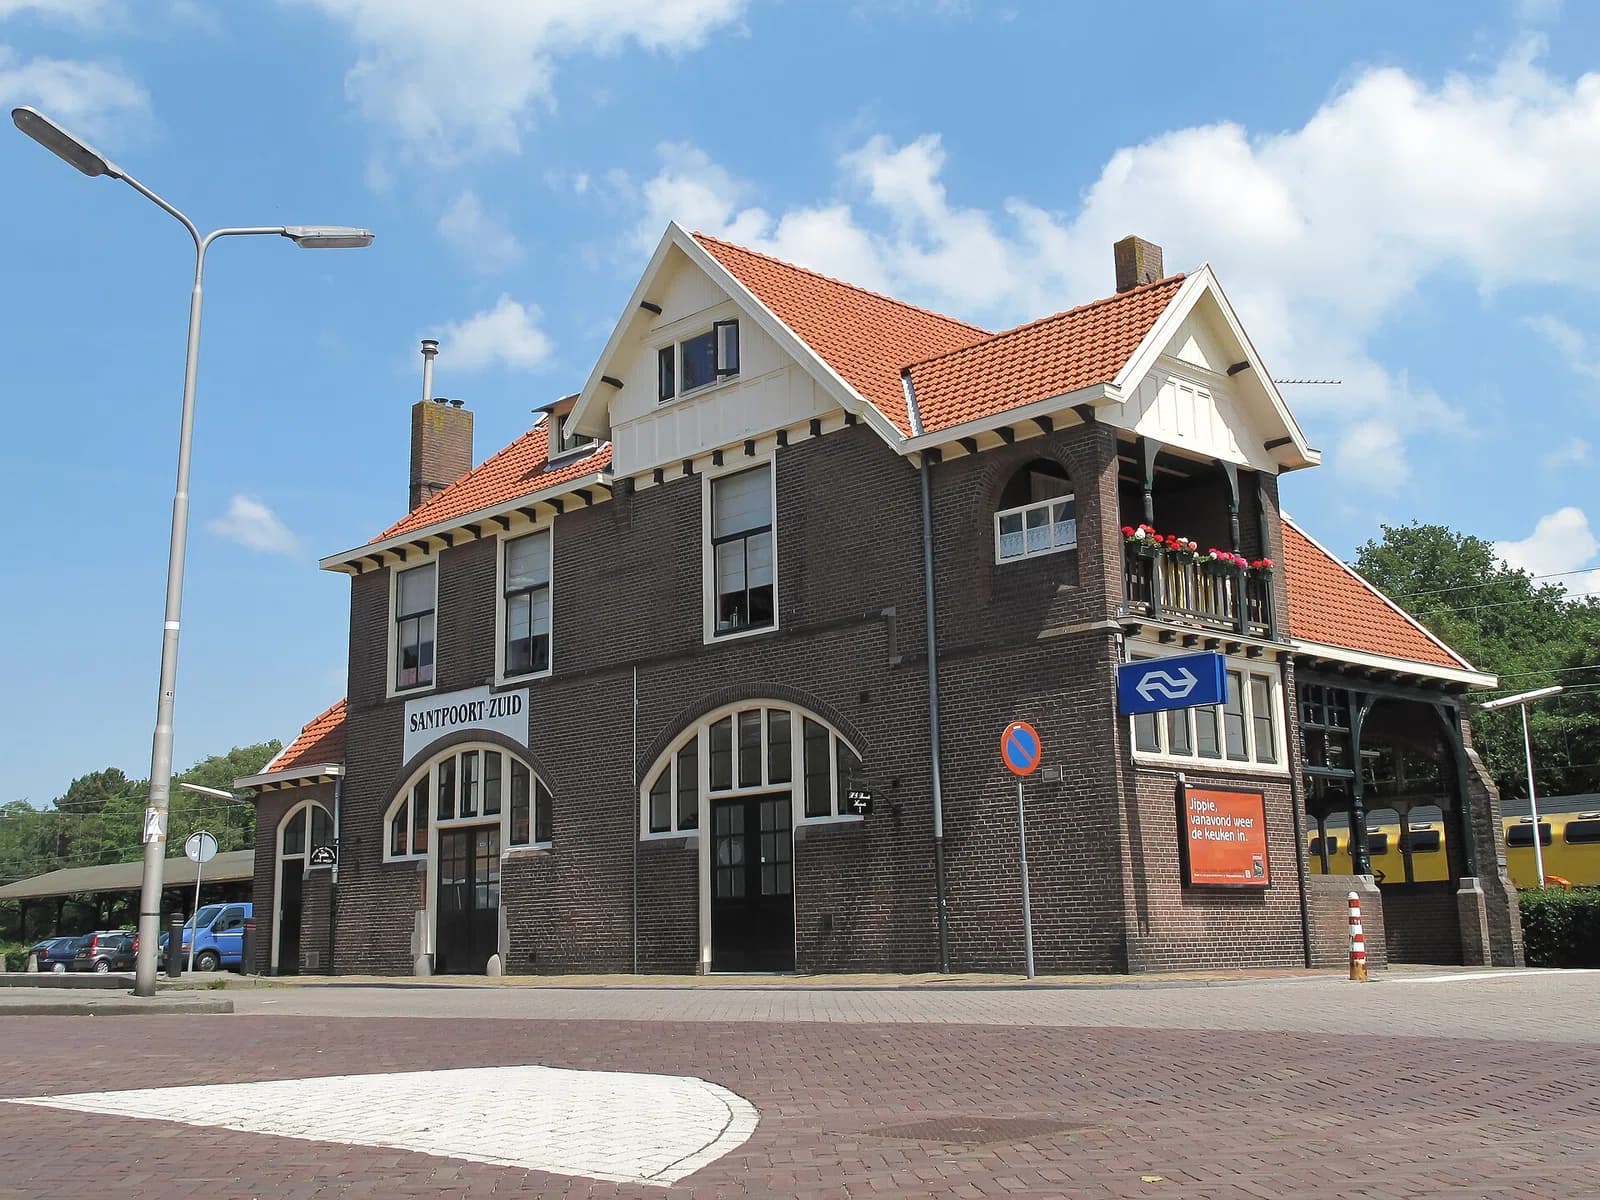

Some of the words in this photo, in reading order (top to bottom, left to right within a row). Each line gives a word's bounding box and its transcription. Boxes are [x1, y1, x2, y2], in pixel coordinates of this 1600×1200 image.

[410, 694, 522, 732] SANTPOORT-ZUID
[1190, 797, 1217, 813] Jippie,
[1190, 814, 1231, 827] vanavond
[1233, 818, 1254, 828] weer
[1191, 827, 1203, 840] de
[1204, 827, 1235, 841] keuken
[1237, 829, 1248, 842] in.
